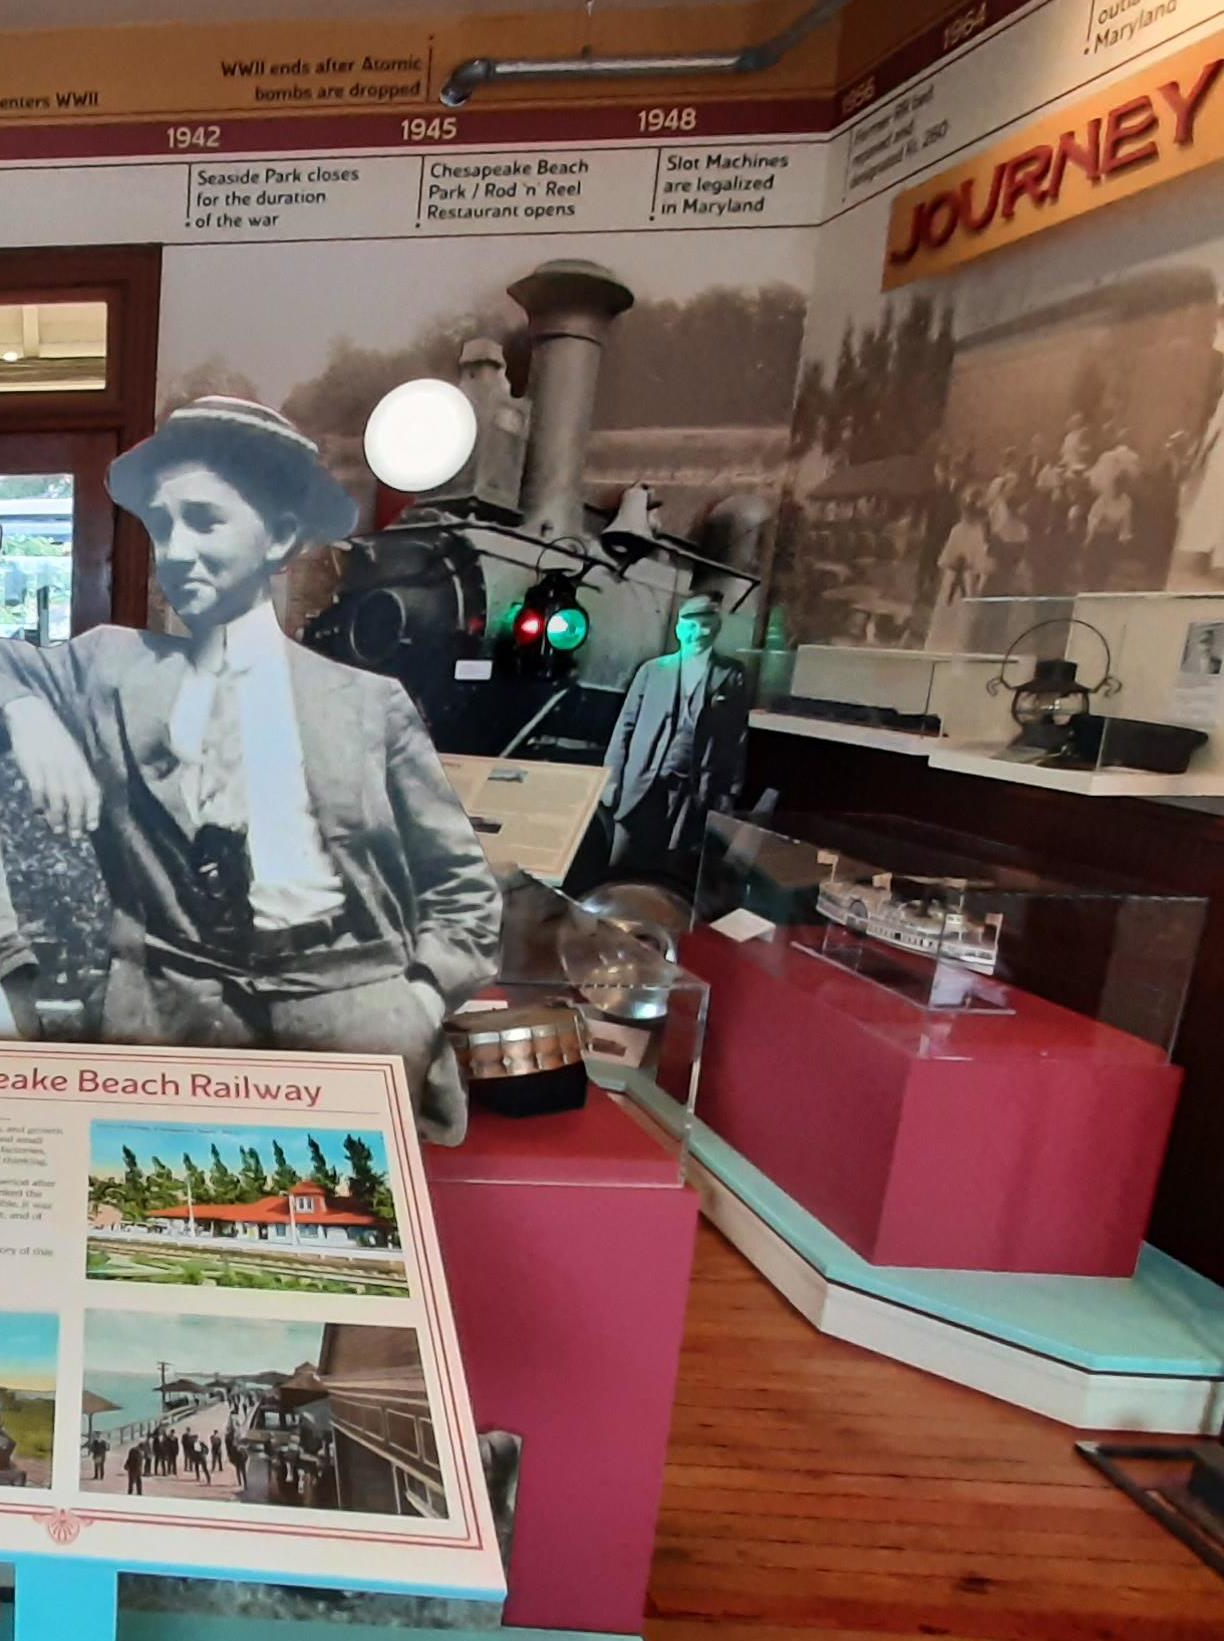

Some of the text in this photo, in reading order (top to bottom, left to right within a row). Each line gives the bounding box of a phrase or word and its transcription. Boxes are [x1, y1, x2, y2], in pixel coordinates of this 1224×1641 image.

[220, 54, 422, 77] WWII ends after Atomic
[0, 95, 50, 110] enters
[55, 91, 99, 108] WWII
[255, 81, 421, 101] bombs are dropped
[400, 117, 458, 141] 1945
[638, 107, 697, 132] 1948
[166, 125, 221, 149] 1942
[431, 157, 589, 181] Chesapeake Beach
[667, 153, 789, 172] Slot Machines
[889, 58, 1224, 265] JOURNEY
[197, 165, 359, 187] Seaside Park closes
[664, 174, 775, 195] are legalized
[196, 190, 326, 208] for the duration
[429, 183, 466, 201] Park
[484, 181, 517, 199] Rod
[545, 180, 582, 197] Reel
[427, 203, 576, 220] Restaurant opens
[661, 197, 765, 217] in Maryland
[195, 213, 279, 229] of the war
[78, 1069, 180, 1097] Beach
[190, 1073, 322, 1107] Railway
